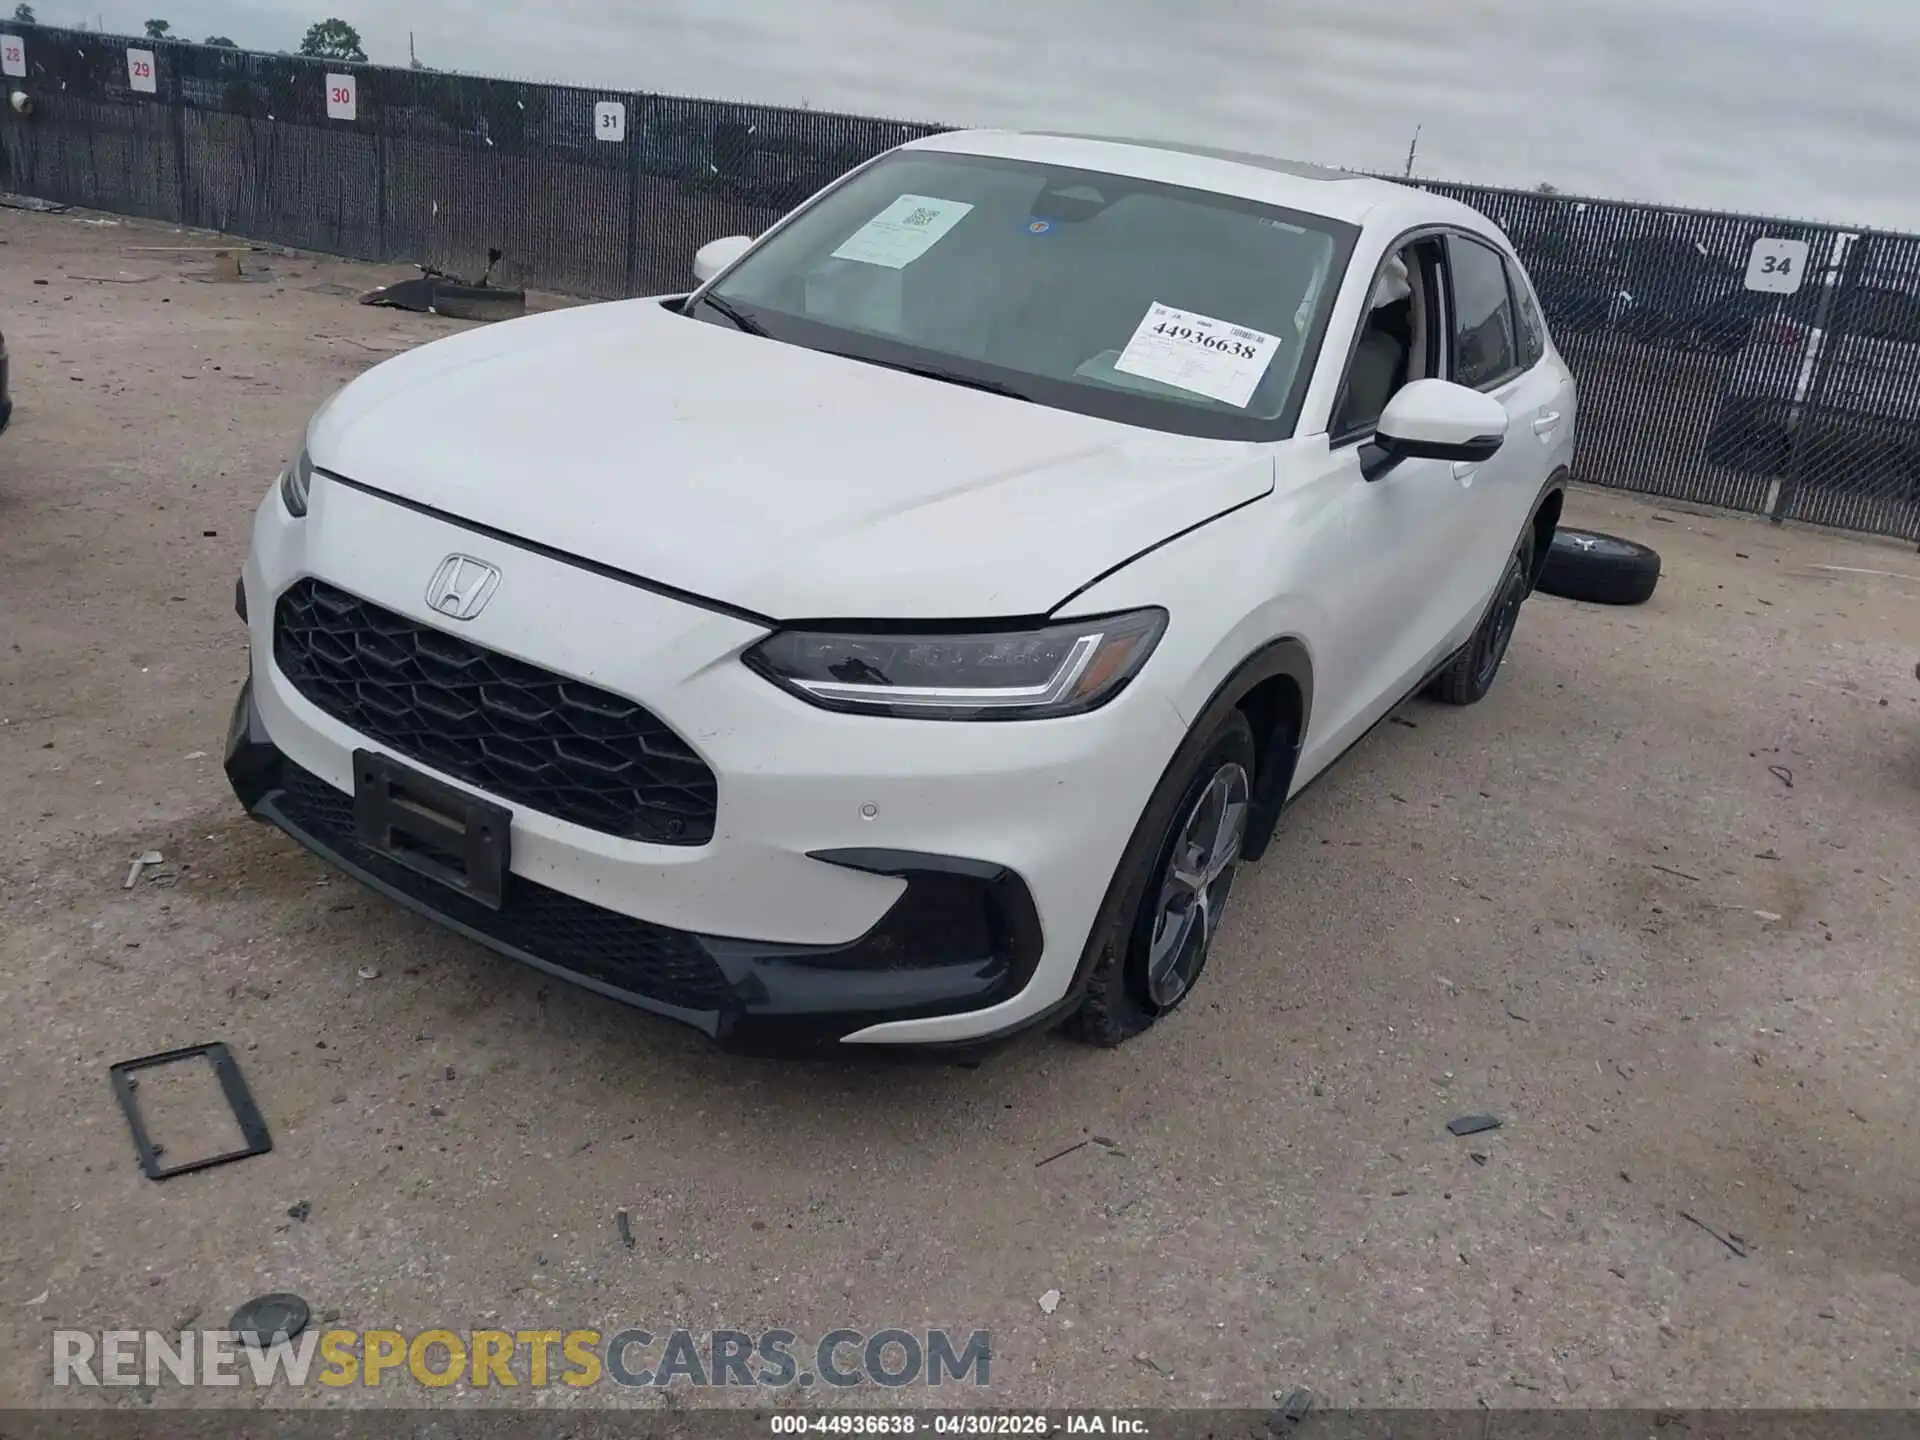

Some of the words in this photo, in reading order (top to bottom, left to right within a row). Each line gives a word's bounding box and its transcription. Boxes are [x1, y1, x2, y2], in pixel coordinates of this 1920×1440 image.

[133, 61, 150, 78] 29
[331, 87, 350, 104] 30
[602, 114, 617, 129] 31
[1760, 255, 1792, 276] 34
[1152, 321, 1257, 361] 44936638
